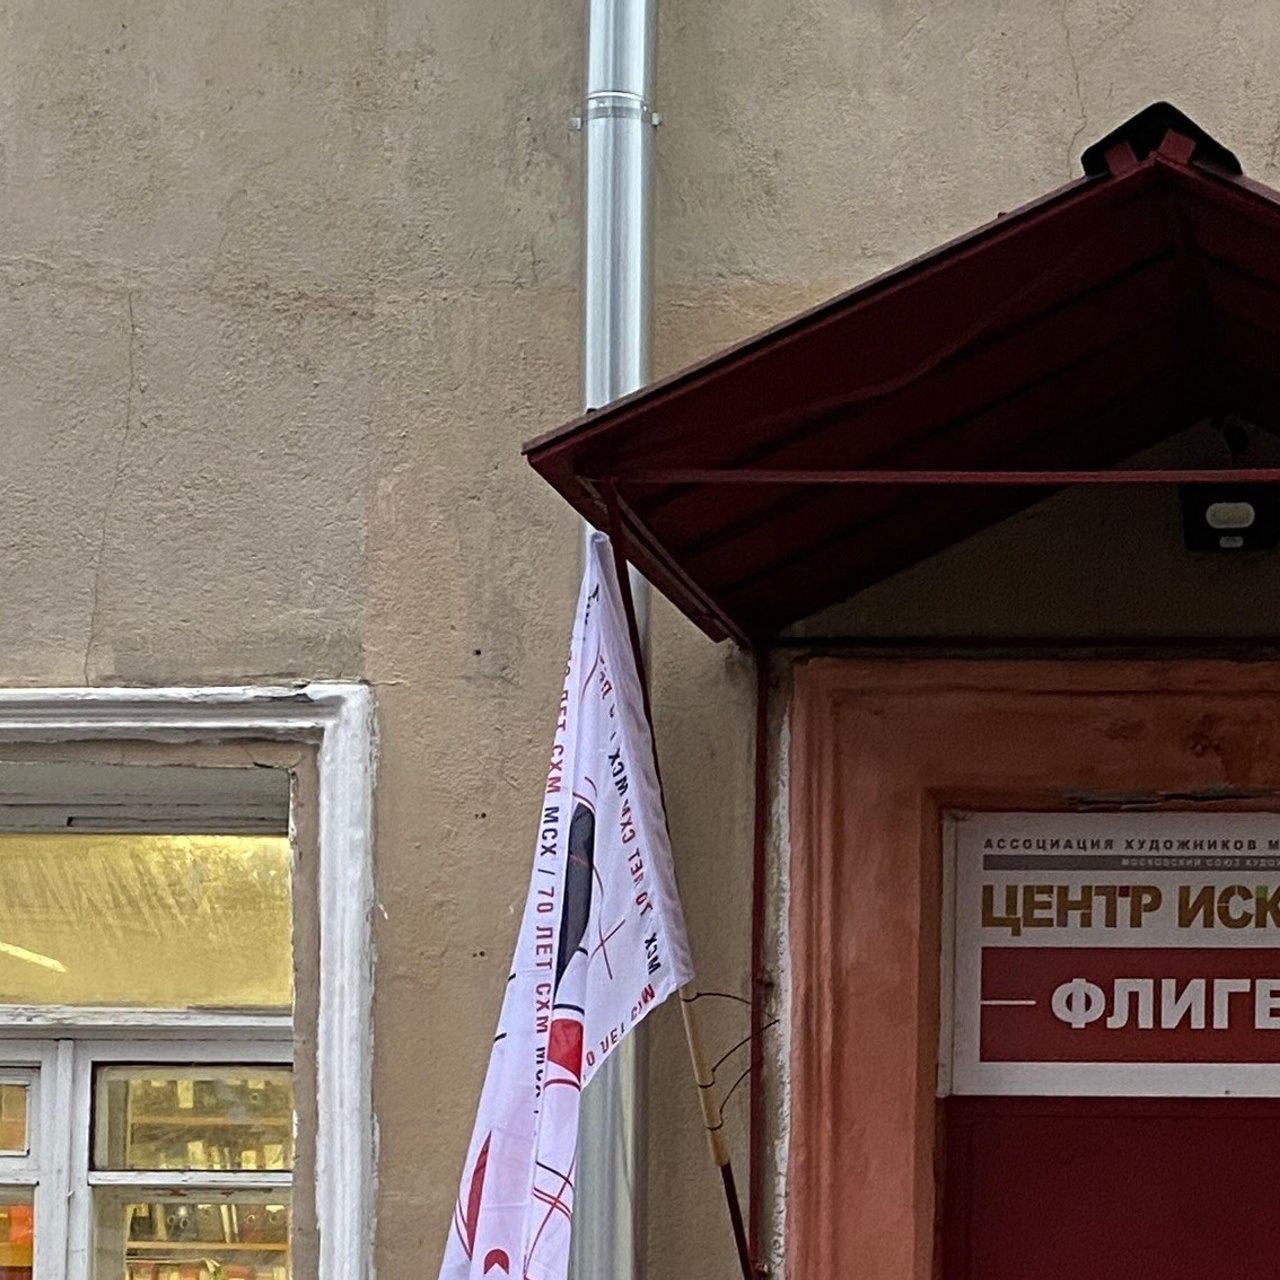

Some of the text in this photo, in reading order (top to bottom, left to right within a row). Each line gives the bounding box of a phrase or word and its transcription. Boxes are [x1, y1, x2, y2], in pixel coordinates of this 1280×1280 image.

[539, 806, 560, 856] МСХ
[983, 838, 1114, 852] АССОЦИАЦИЯ
[1125, 838, 1257, 852] ХУДОЖНИКОВ
[1121, 857, 1200, 867] МОСКОВСКИЙ
[1206, 858, 1241, 867] СОЮЗ
[536, 886, 555, 914] 70
[981, 884, 1163, 937] ЦЕНТР
[536, 925, 554, 970] ЛЕТ
[536, 982, 552, 1034] СХМ
